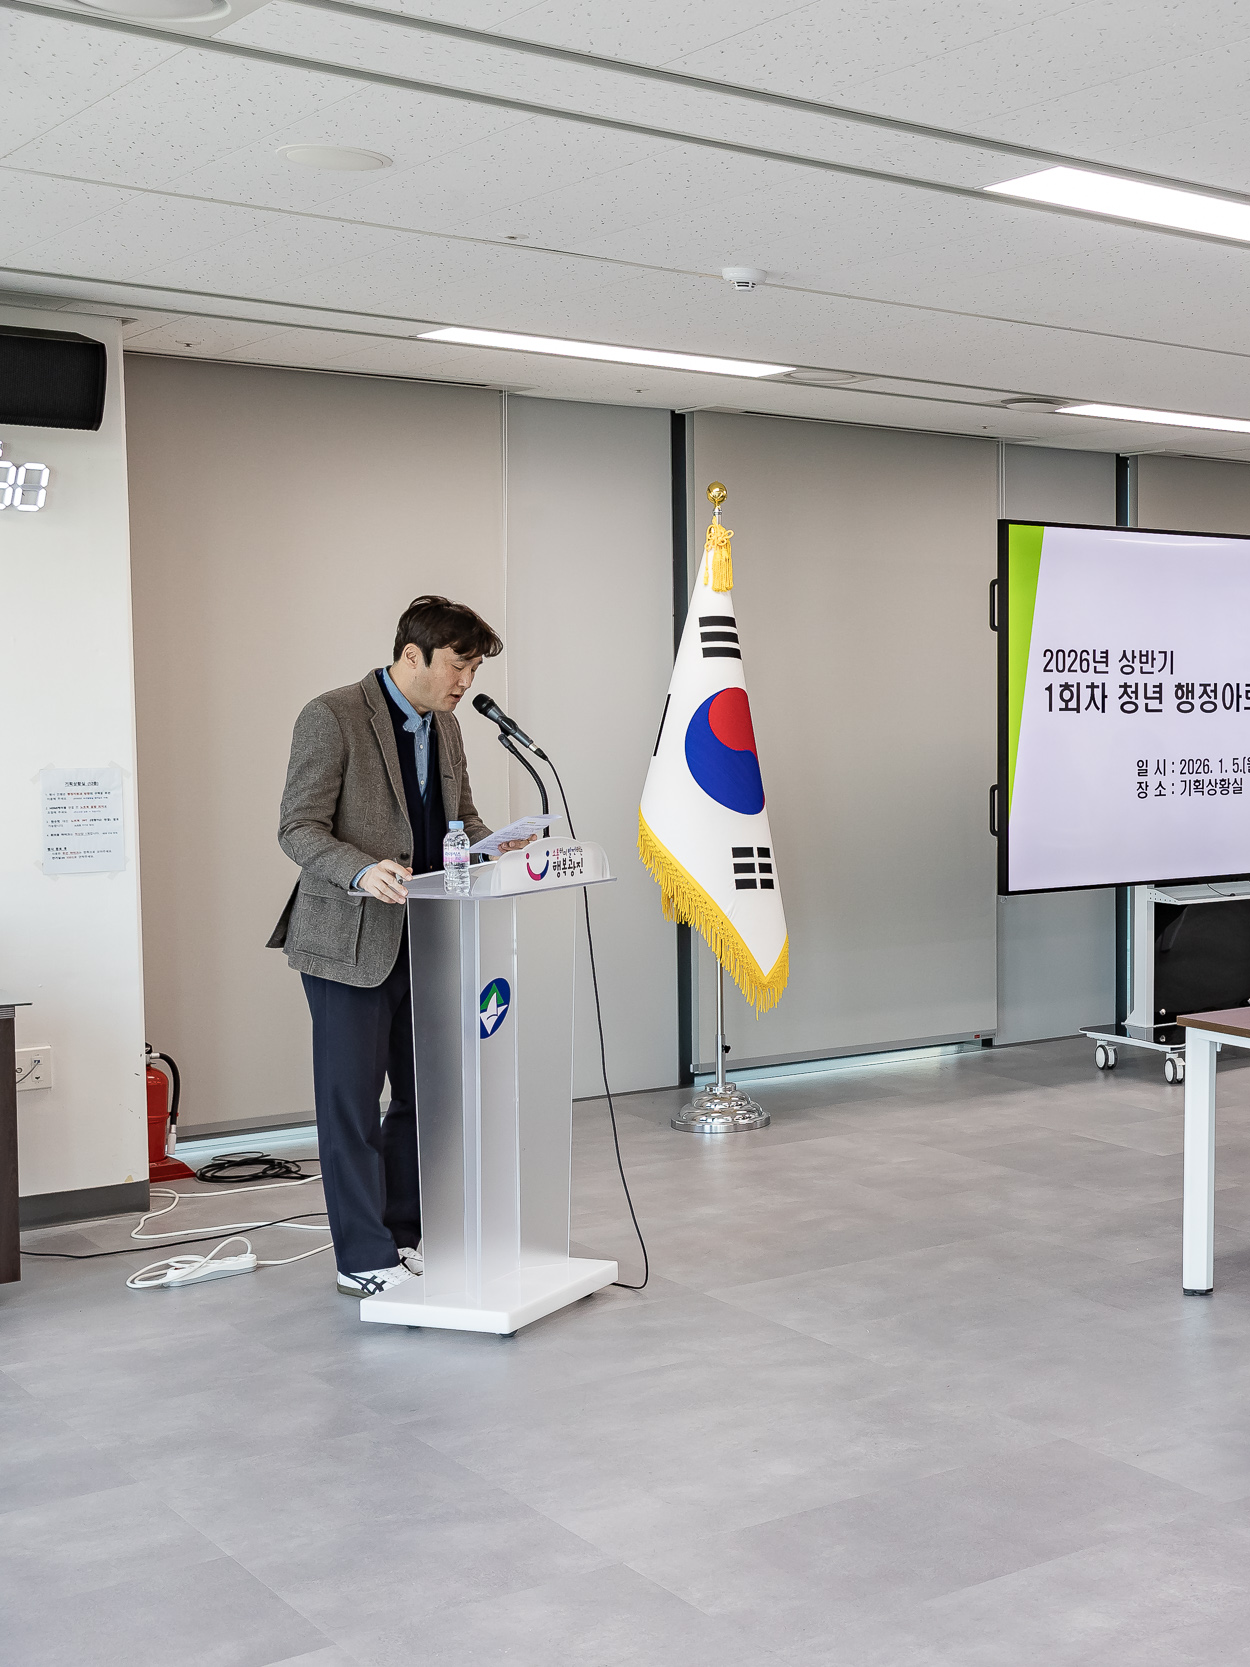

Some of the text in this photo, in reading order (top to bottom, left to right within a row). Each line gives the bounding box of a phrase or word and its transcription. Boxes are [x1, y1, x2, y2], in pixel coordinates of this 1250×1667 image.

[1043, 649, 1174, 675] 2026년 상반기
[1044, 682, 1108, 713] 1회차
[1117, 682, 1163, 714] 청년
[1136, 759, 1149, 777] 일
[1154, 758, 1166, 776] 시
[1179, 758, 1213, 775] 2026.
[1218, 758, 1228, 773] 1.
[1136, 780, 1149, 799] 장
[1154, 780, 1167, 797] 소
[1180, 777, 1243, 796] 기획상황실
[552, 857, 584, 878] 행복광진
